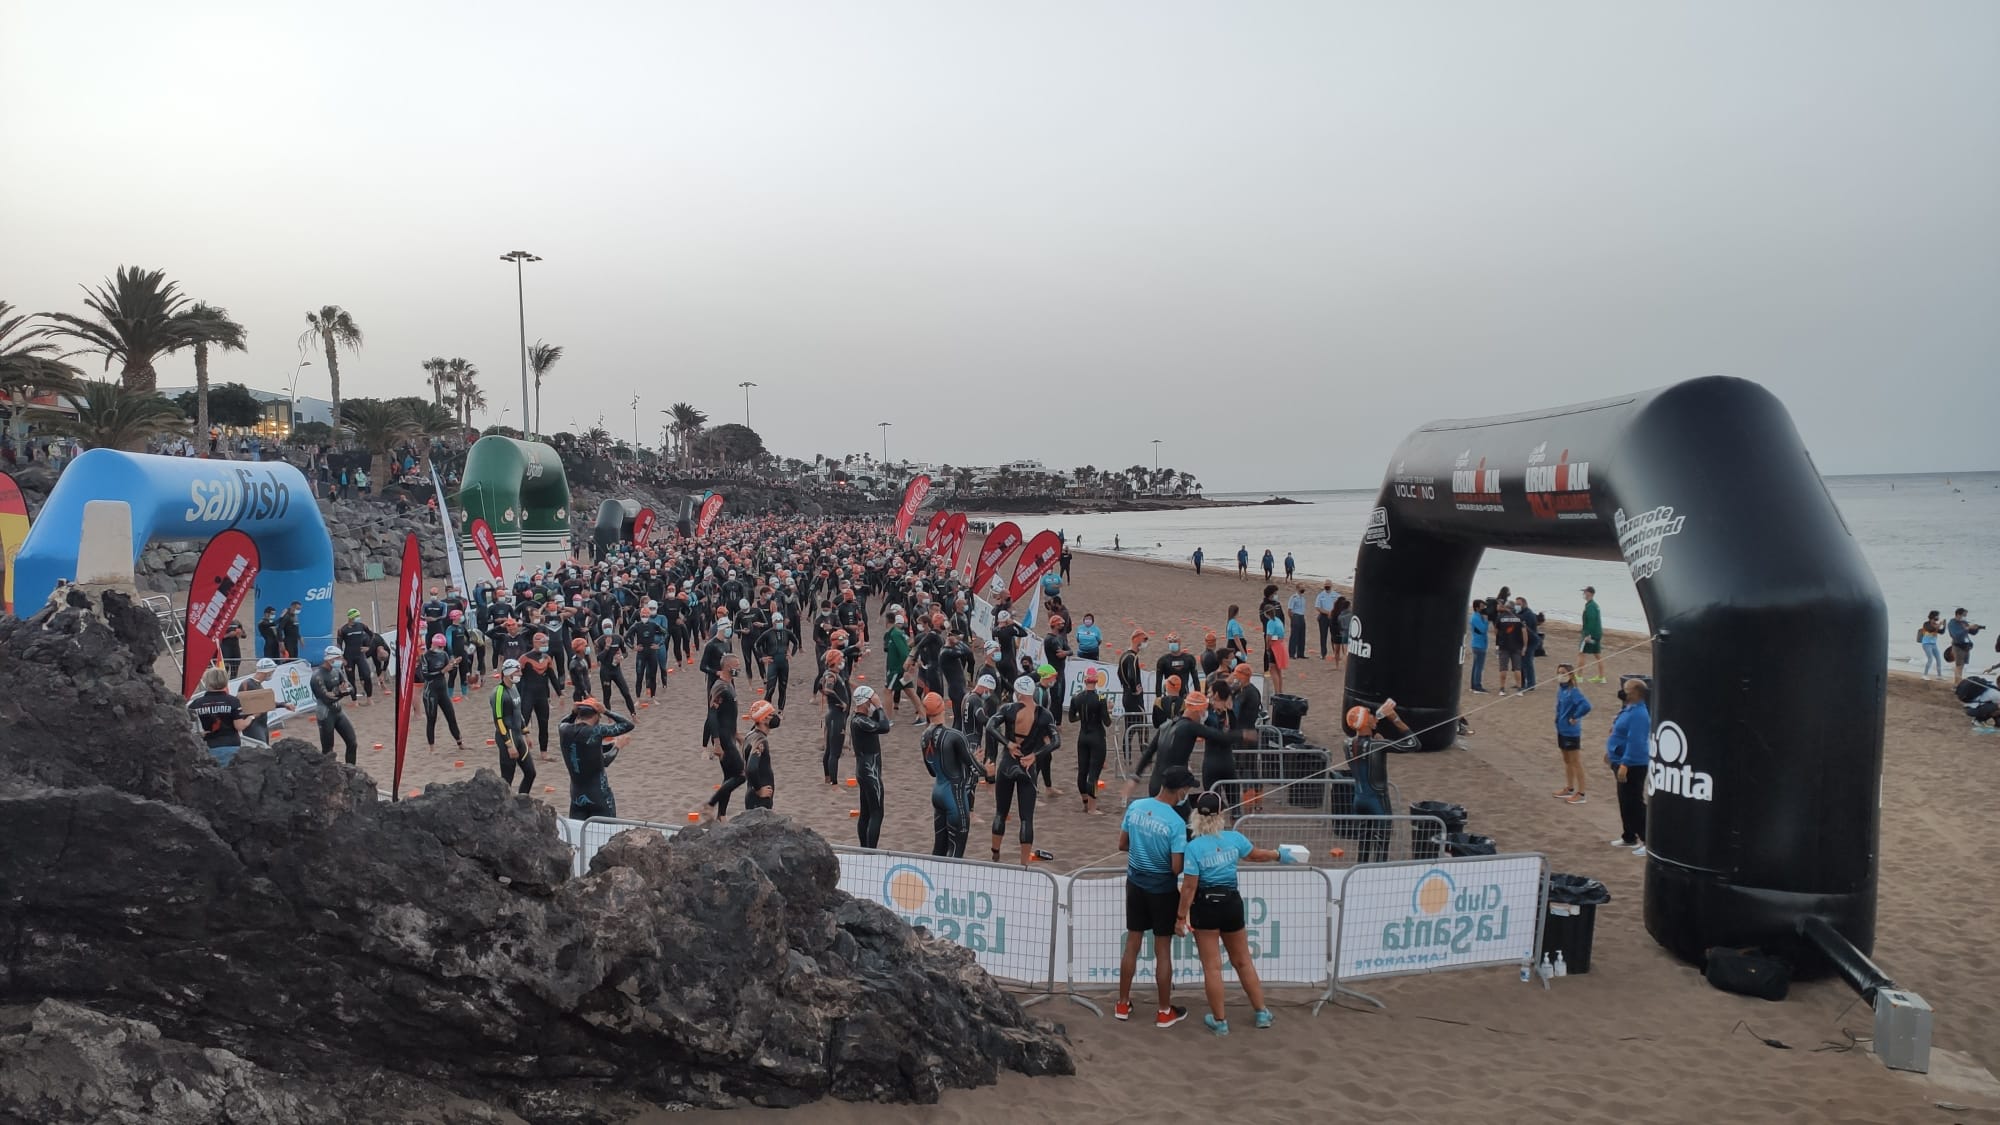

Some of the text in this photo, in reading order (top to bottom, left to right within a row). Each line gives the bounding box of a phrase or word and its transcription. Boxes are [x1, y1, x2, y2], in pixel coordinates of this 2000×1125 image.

[185, 469, 290, 528] sailfish
[1619, 507, 1673, 537] anzarote
[196, 553, 249, 636] IRONMAN
[211, 705, 232, 713] LEADER
